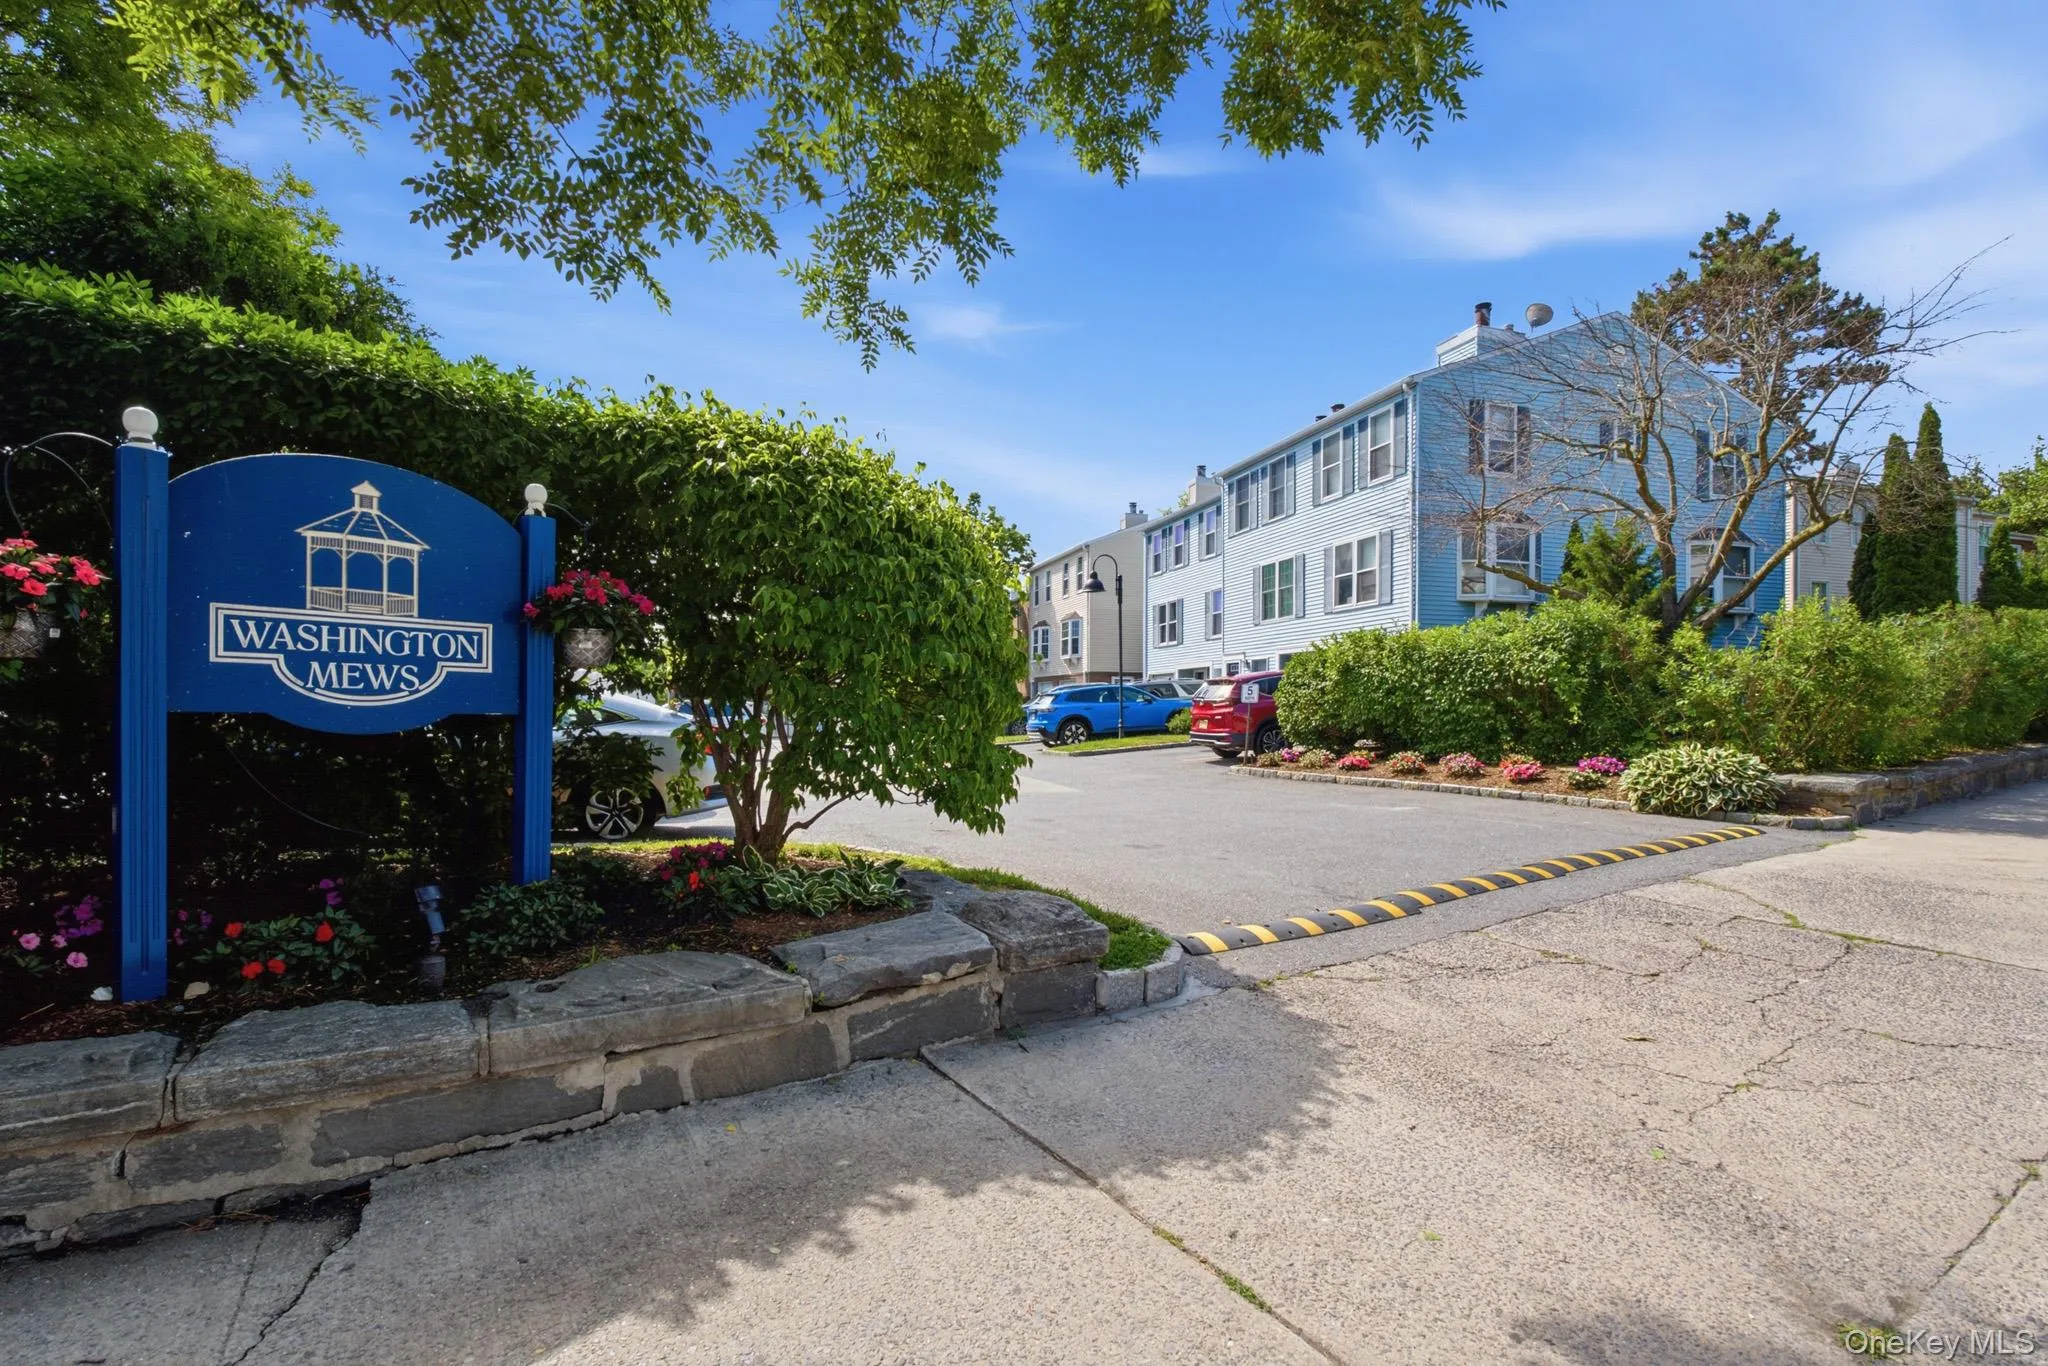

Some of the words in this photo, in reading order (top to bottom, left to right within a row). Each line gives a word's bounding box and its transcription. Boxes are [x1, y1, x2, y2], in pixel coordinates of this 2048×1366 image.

[230, 619, 479, 659] WASHINGTON
[305, 661, 420, 690] MEWS
[1247, 685, 1254, 696] 5
